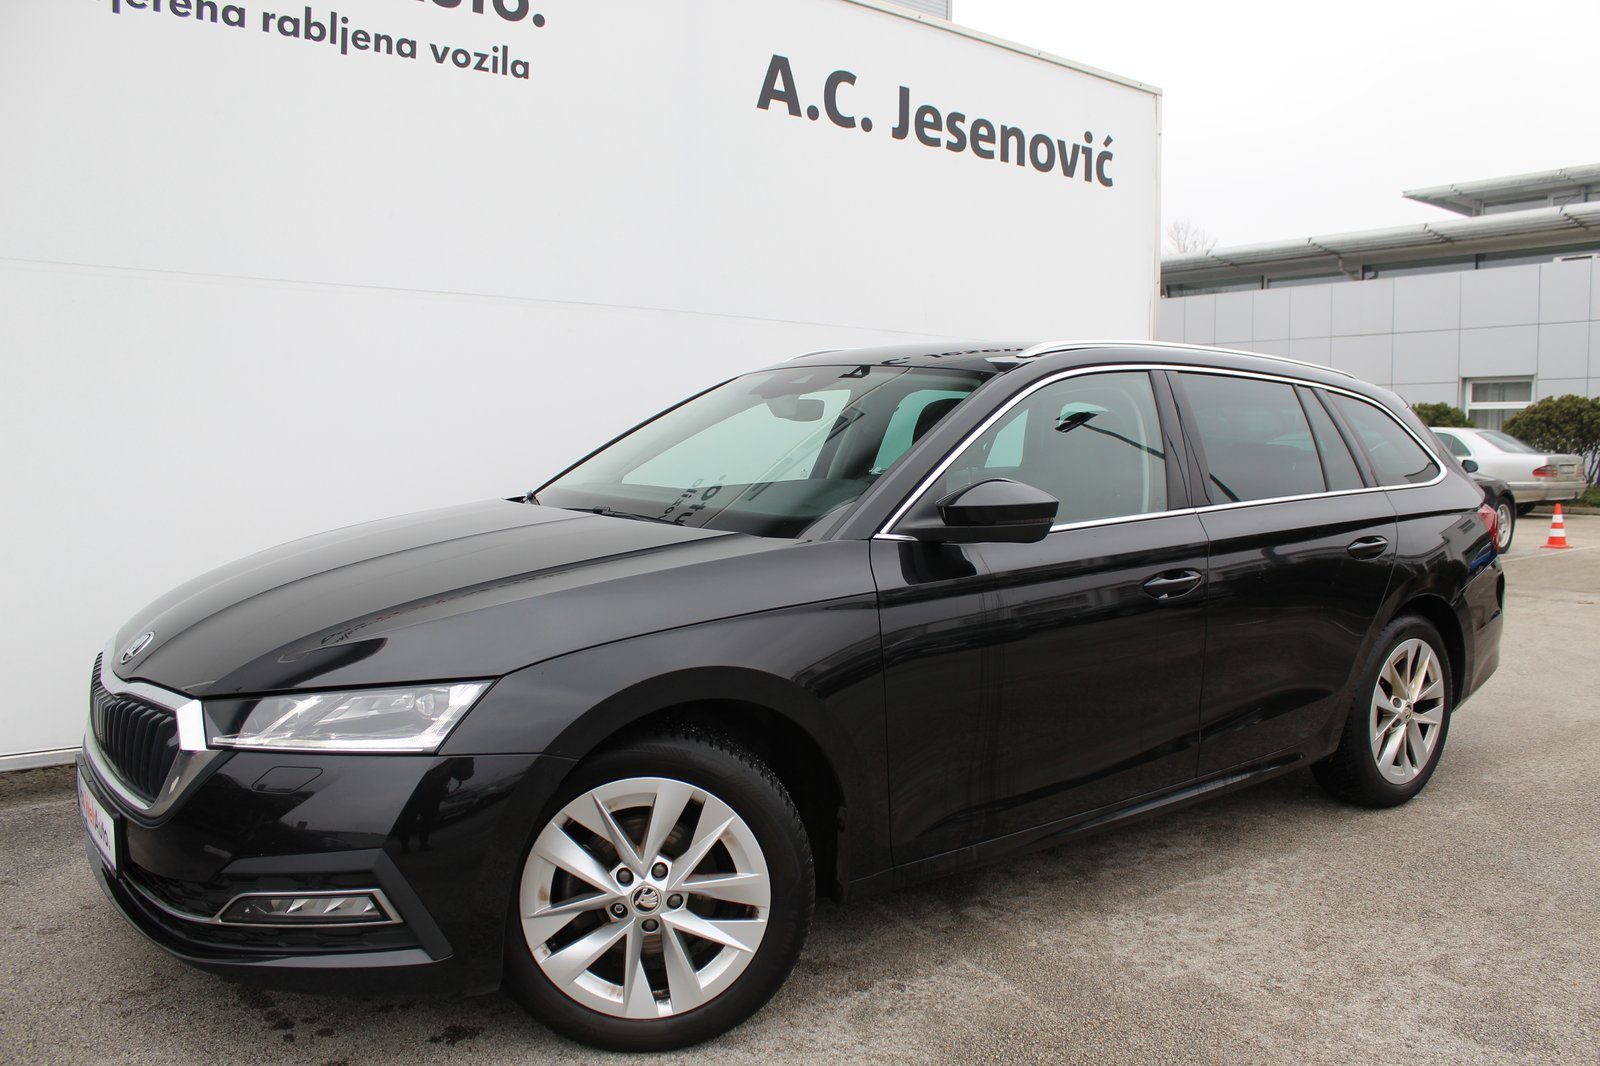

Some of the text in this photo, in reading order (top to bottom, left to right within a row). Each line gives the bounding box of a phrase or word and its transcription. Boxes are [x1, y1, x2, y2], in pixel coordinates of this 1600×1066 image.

[262, 7, 417, 58] rabljena
[429, 44, 530, 79] vozila
[756, 54, 1114, 188] A.C. Jesenović
